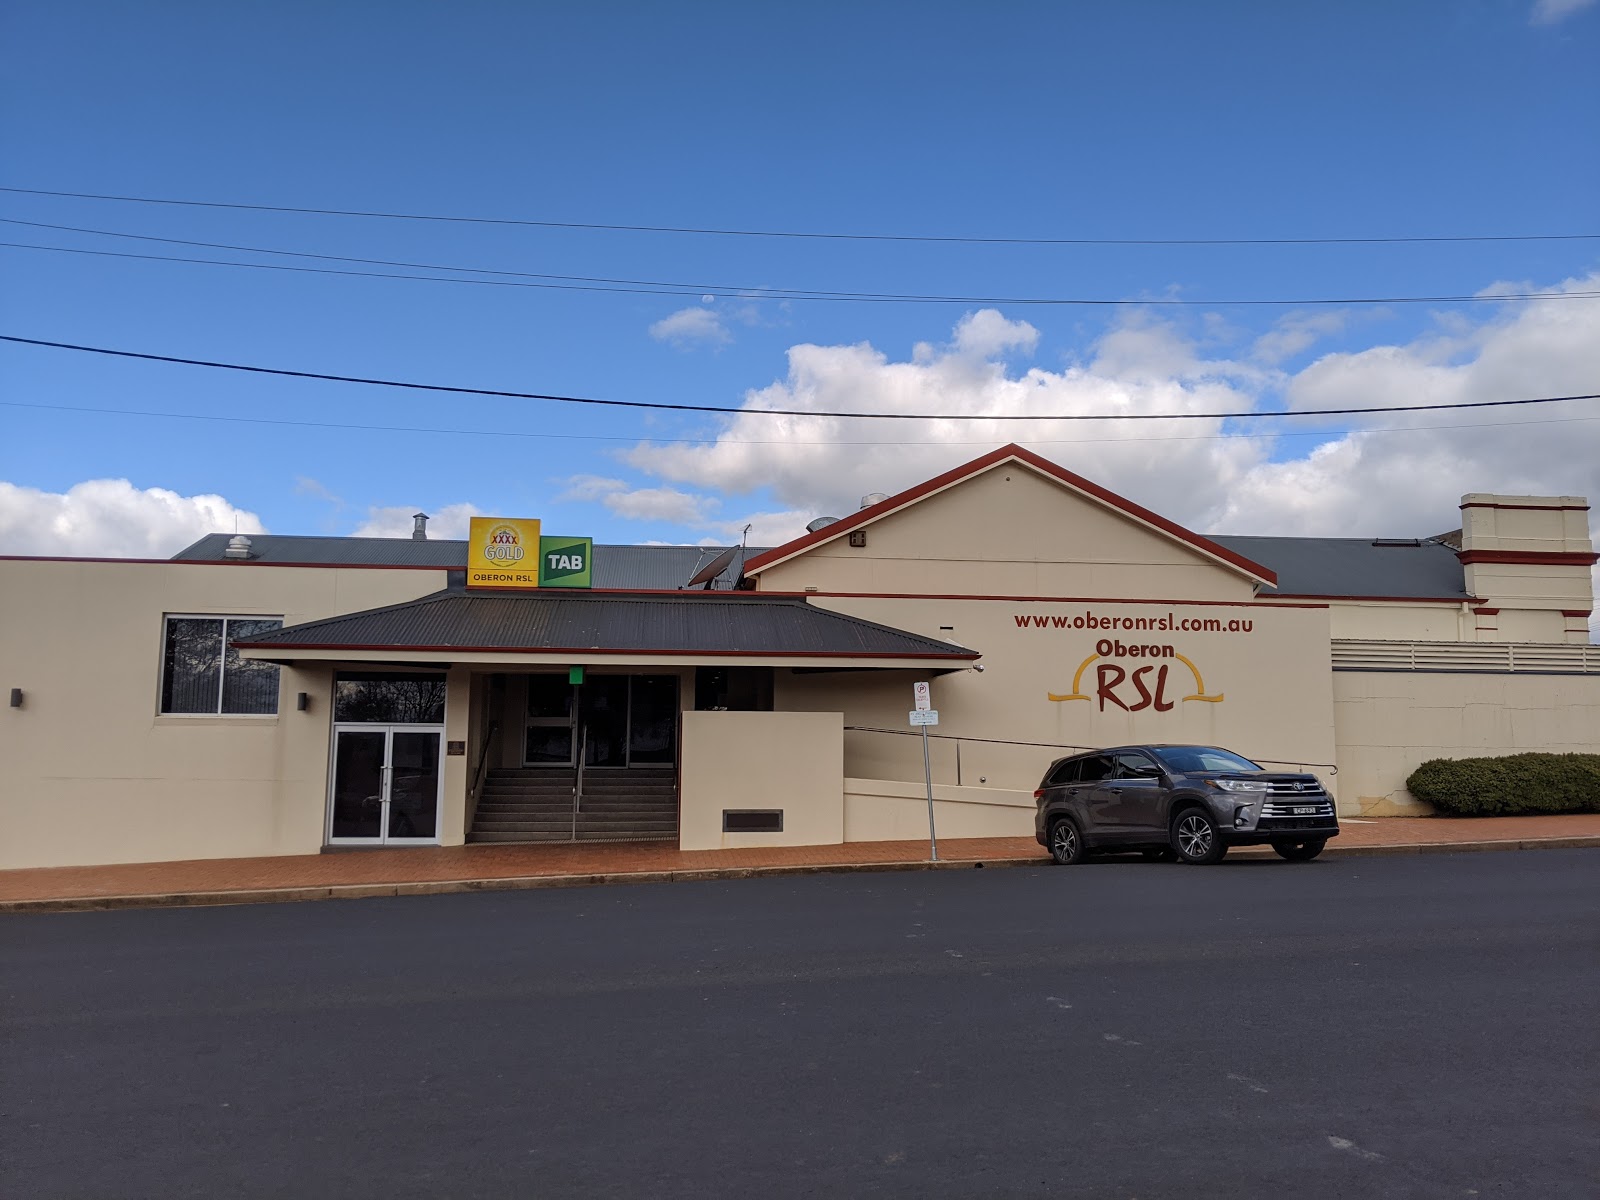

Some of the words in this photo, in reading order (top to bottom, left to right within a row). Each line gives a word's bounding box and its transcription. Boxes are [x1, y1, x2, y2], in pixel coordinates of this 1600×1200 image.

[491, 535, 518, 544] XXXX
[484, 545, 524, 560] GOLD
[548, 554, 583, 570] TAB
[516, 574, 533, 582] RSL
[1014, 611, 1253, 632] www.oberonrsl.com.au
[1096, 639, 1175, 658] Oberon
[1096, 664, 1175, 712] RSL
